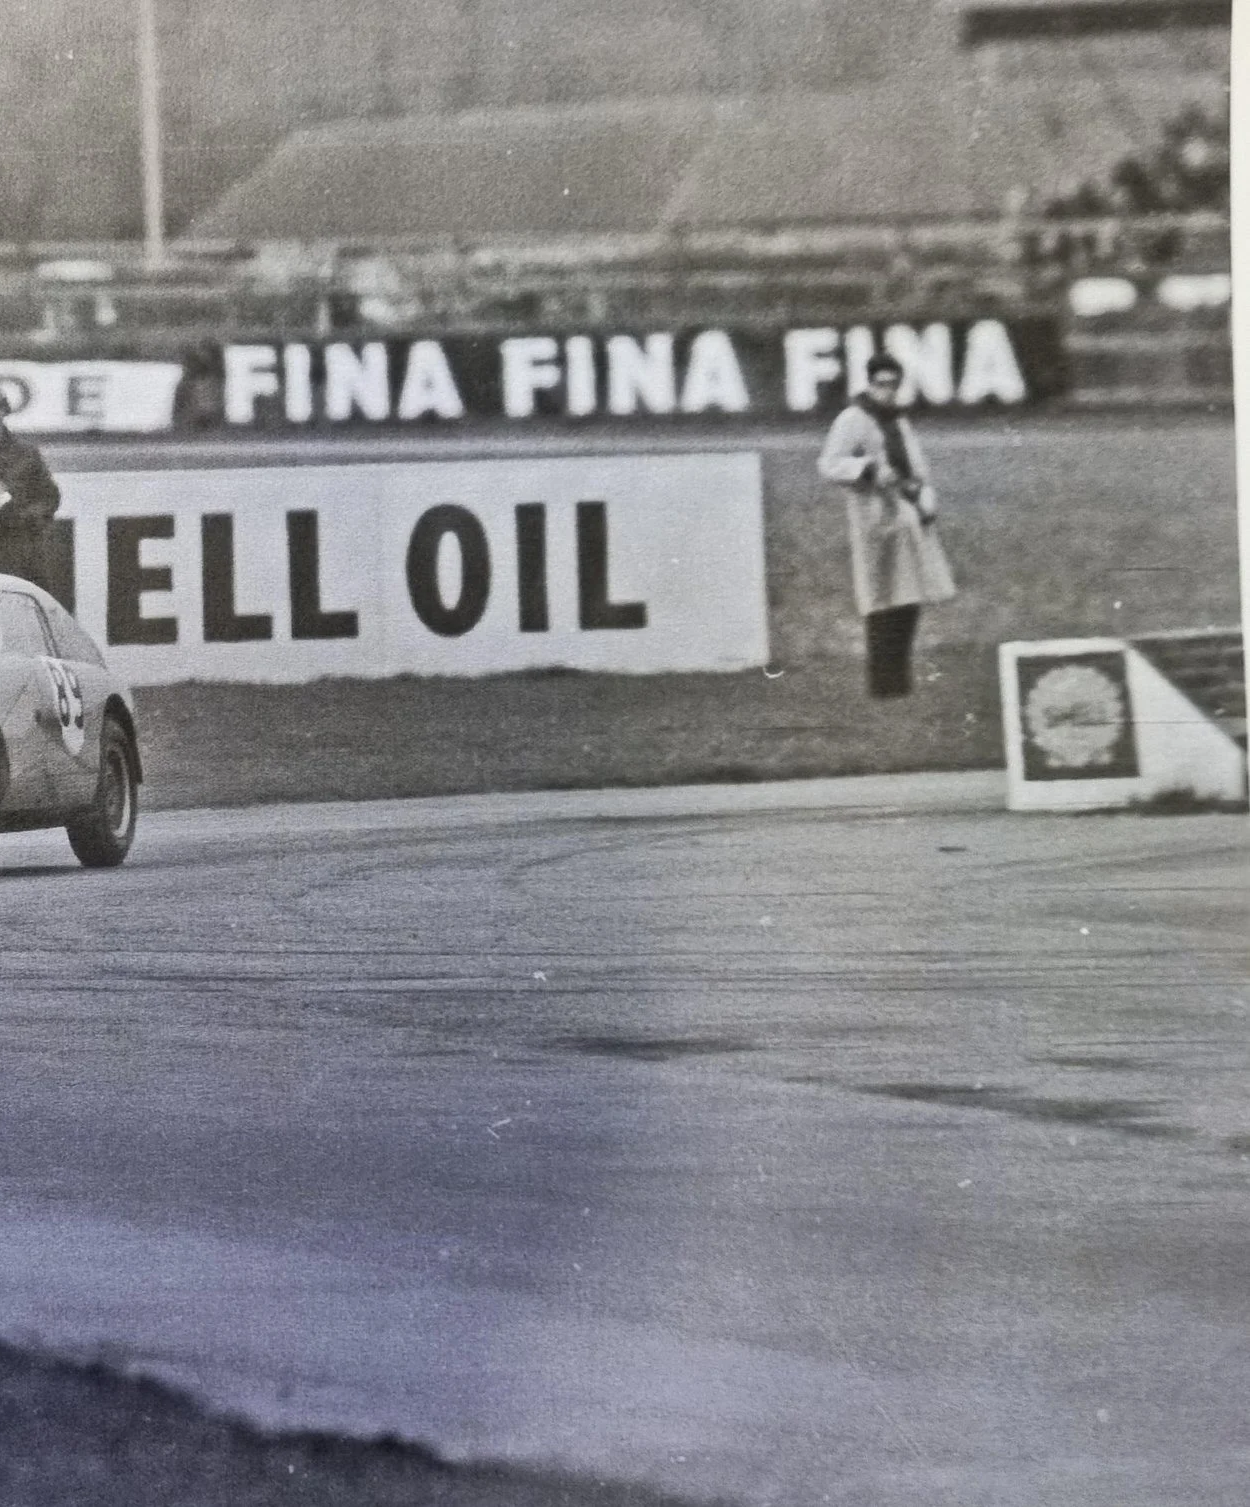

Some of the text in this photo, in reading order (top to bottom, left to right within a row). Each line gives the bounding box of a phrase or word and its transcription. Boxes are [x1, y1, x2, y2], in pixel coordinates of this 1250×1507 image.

[223, 318, 1027, 424] FINA FINA FINA
[405, 500, 648, 638] OIL
